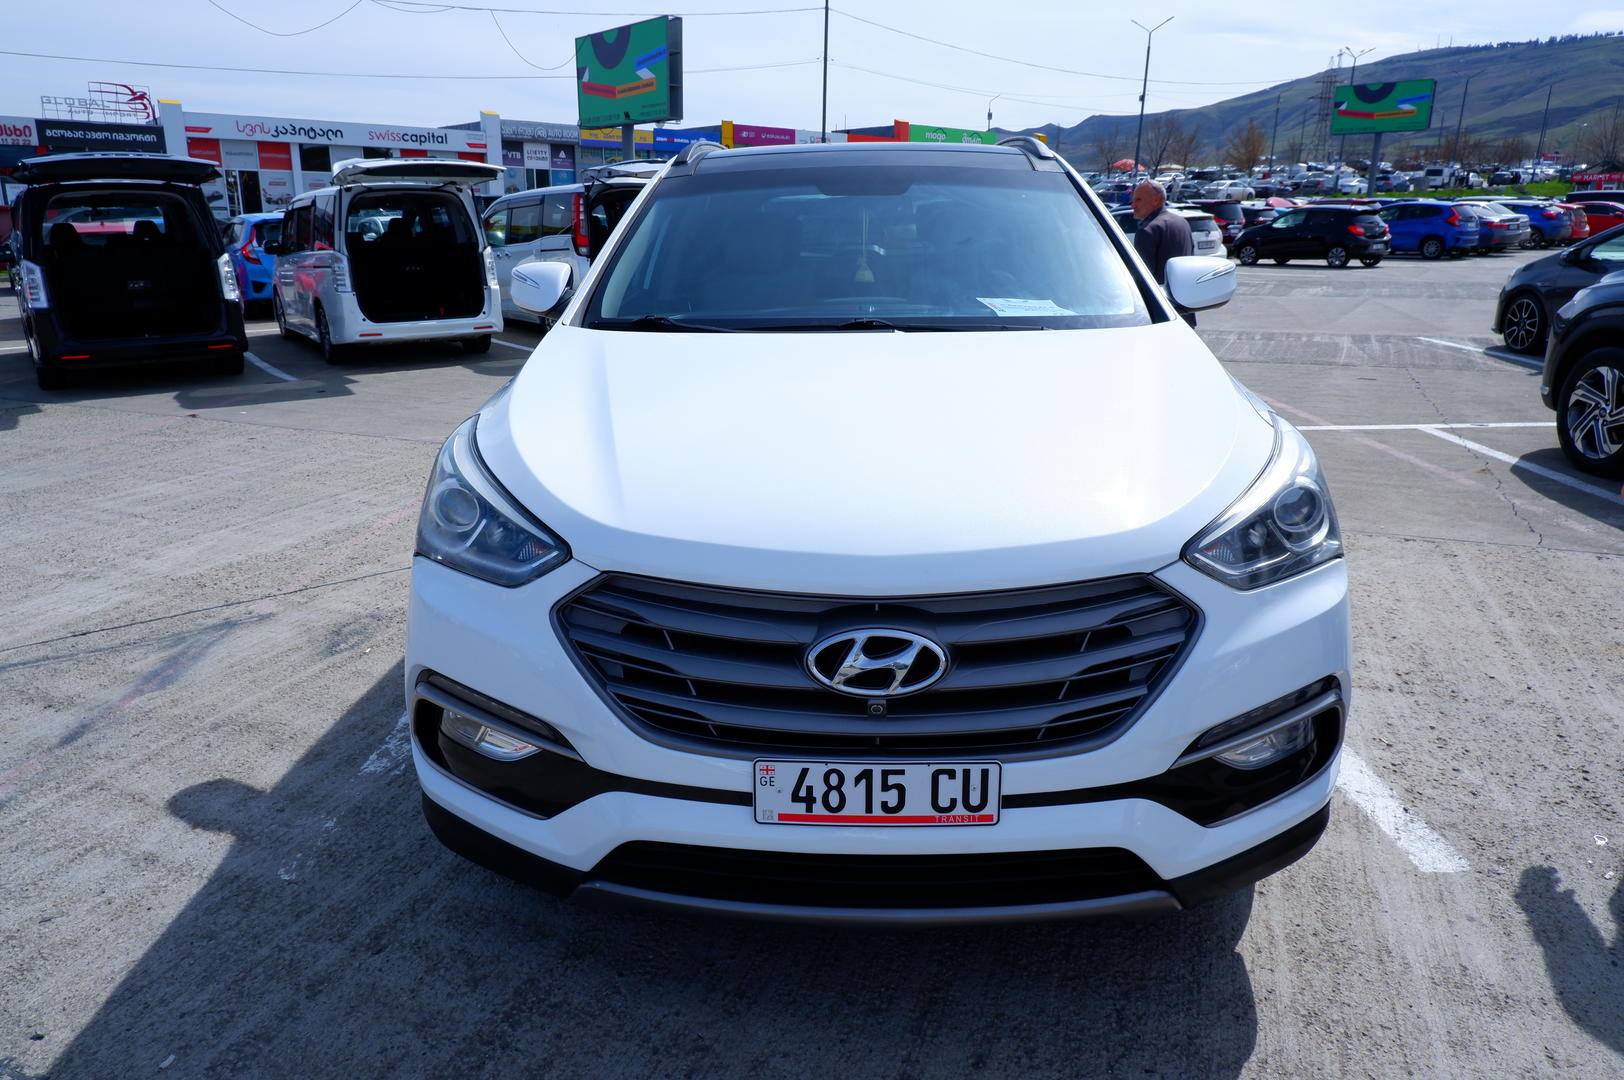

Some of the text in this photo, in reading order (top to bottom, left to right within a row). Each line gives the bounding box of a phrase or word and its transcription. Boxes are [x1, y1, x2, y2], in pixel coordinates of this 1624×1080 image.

[41, 96, 110, 108] GLOBAL
[236, 120, 343, 140] სვისკაპიტალი
[368, 130, 448, 145] swisscapital
[925, 132, 946, 143] mogo
[508, 151, 521, 159] VTB
[760, 776, 775, 787] GE
[791, 768, 989, 814] 4815 CU
[935, 815, 979, 823] TRANSIT
